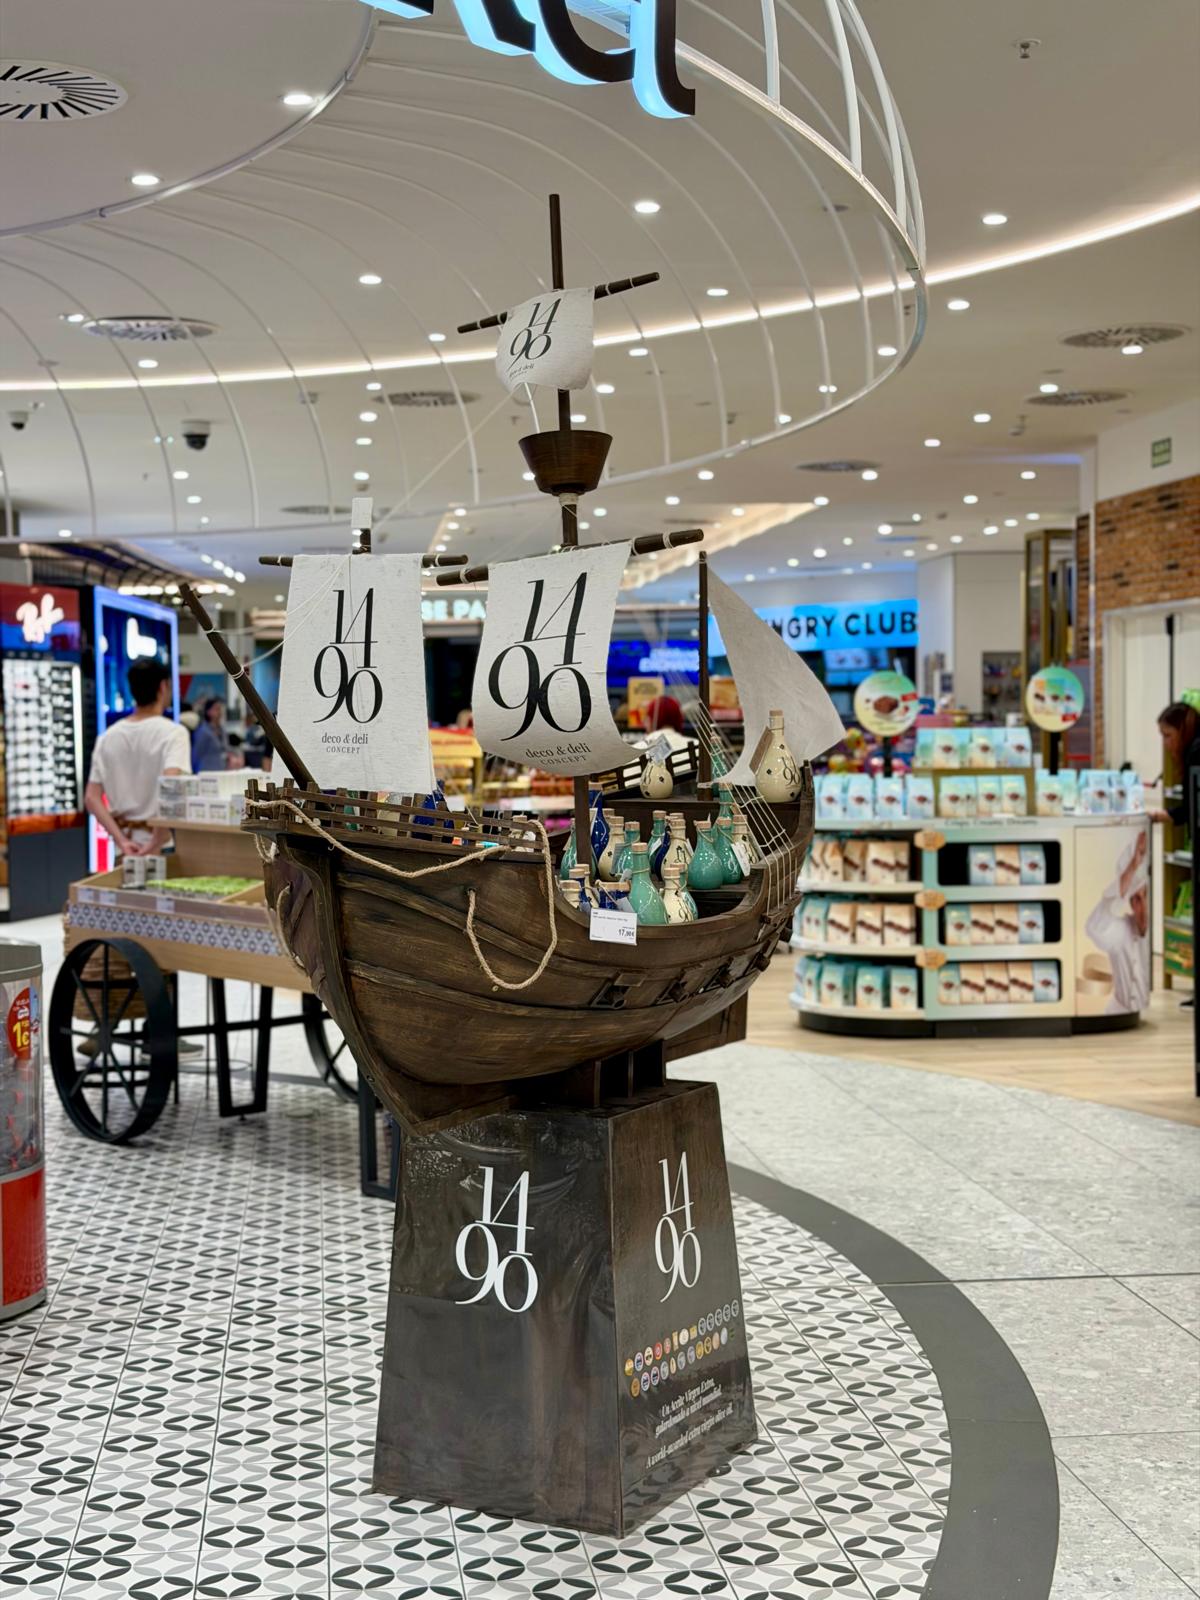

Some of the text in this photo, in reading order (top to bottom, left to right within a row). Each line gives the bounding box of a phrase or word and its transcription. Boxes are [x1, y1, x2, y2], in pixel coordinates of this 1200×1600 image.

[507, 328, 552, 373] 90
[527, 298, 562, 335] 14
[329, 588, 378, 669] 14
[514, 572, 588, 667] 14
[845, 611, 917, 636] CLUB
[313, 645, 383, 724] 90
[488, 644, 592, 741] 90
[322, 732, 369, 745] deco & deli
[326, 746, 360, 754] CONCEPT
[525, 742, 591, 759] deco & deli
[540, 755, 587, 766] CONCEPT
[475, 1166, 534, 1256] 14
[658, 1151, 695, 1234] 14
[455, 1223, 539, 1313] 90
[655, 1216, 701, 1303] 90
